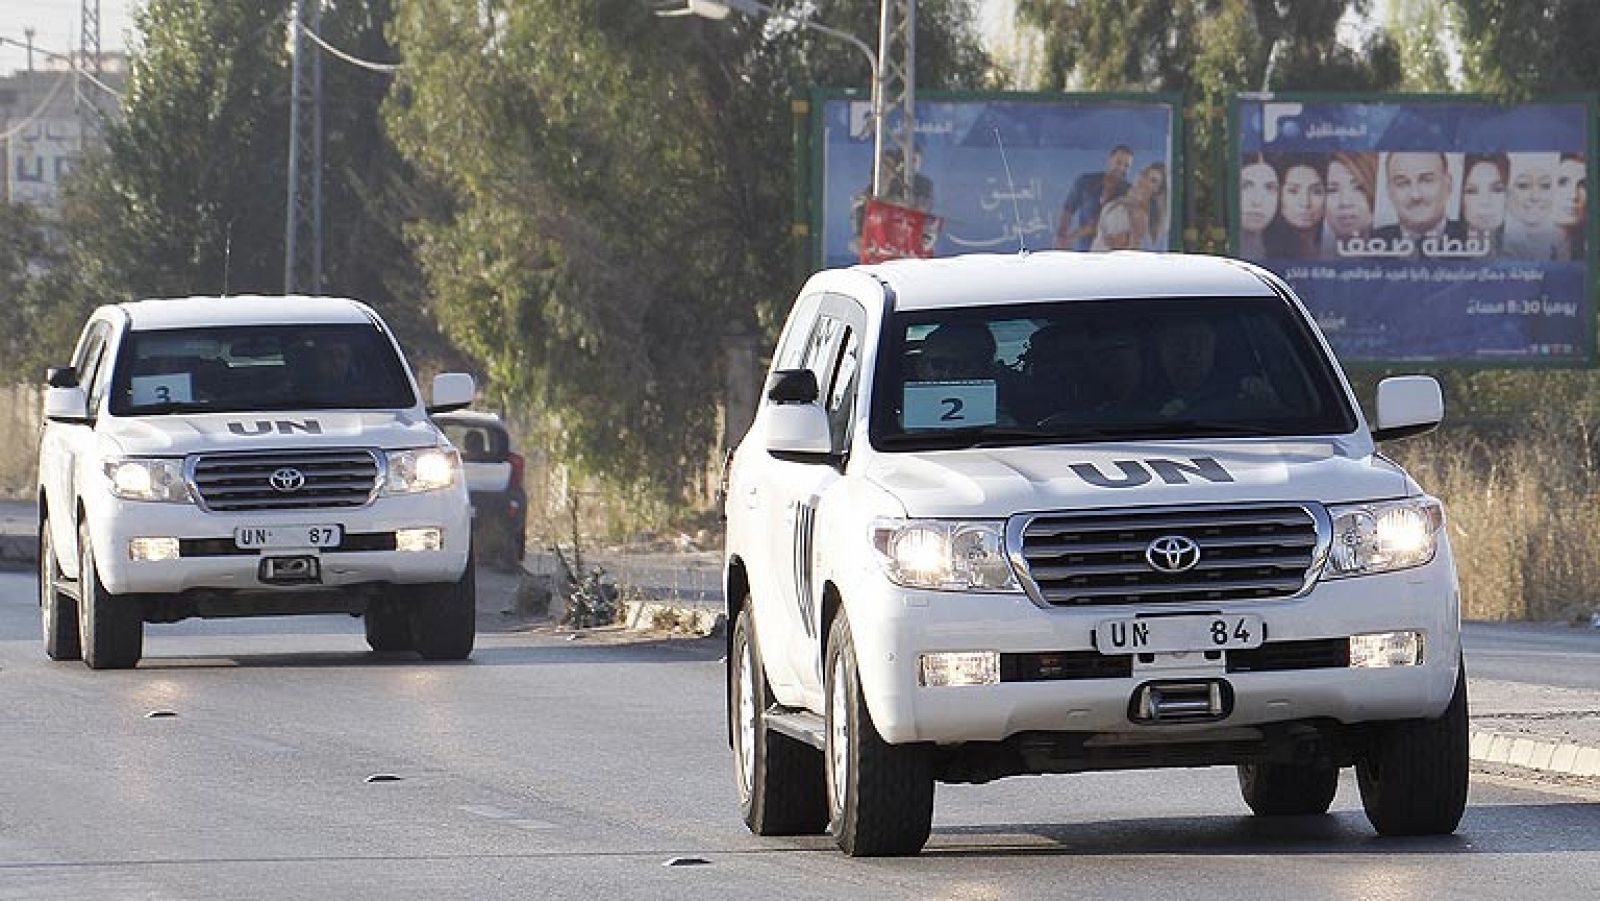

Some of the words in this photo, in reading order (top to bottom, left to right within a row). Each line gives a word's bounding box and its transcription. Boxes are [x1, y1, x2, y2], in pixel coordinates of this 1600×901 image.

[1337, 229, 1415, 258] ضعف
[1422, 229, 1490, 258] نقطة
[155, 385, 170, 401] 3
[940, 398, 965, 422] 2
[227, 420, 322, 437] UN
[1067, 457, 1235, 489] UN
[241, 529, 266, 545] UN
[309, 527, 333, 545] 87
[1110, 622, 1149, 648] UN
[1210, 618, 1251, 646] 84
